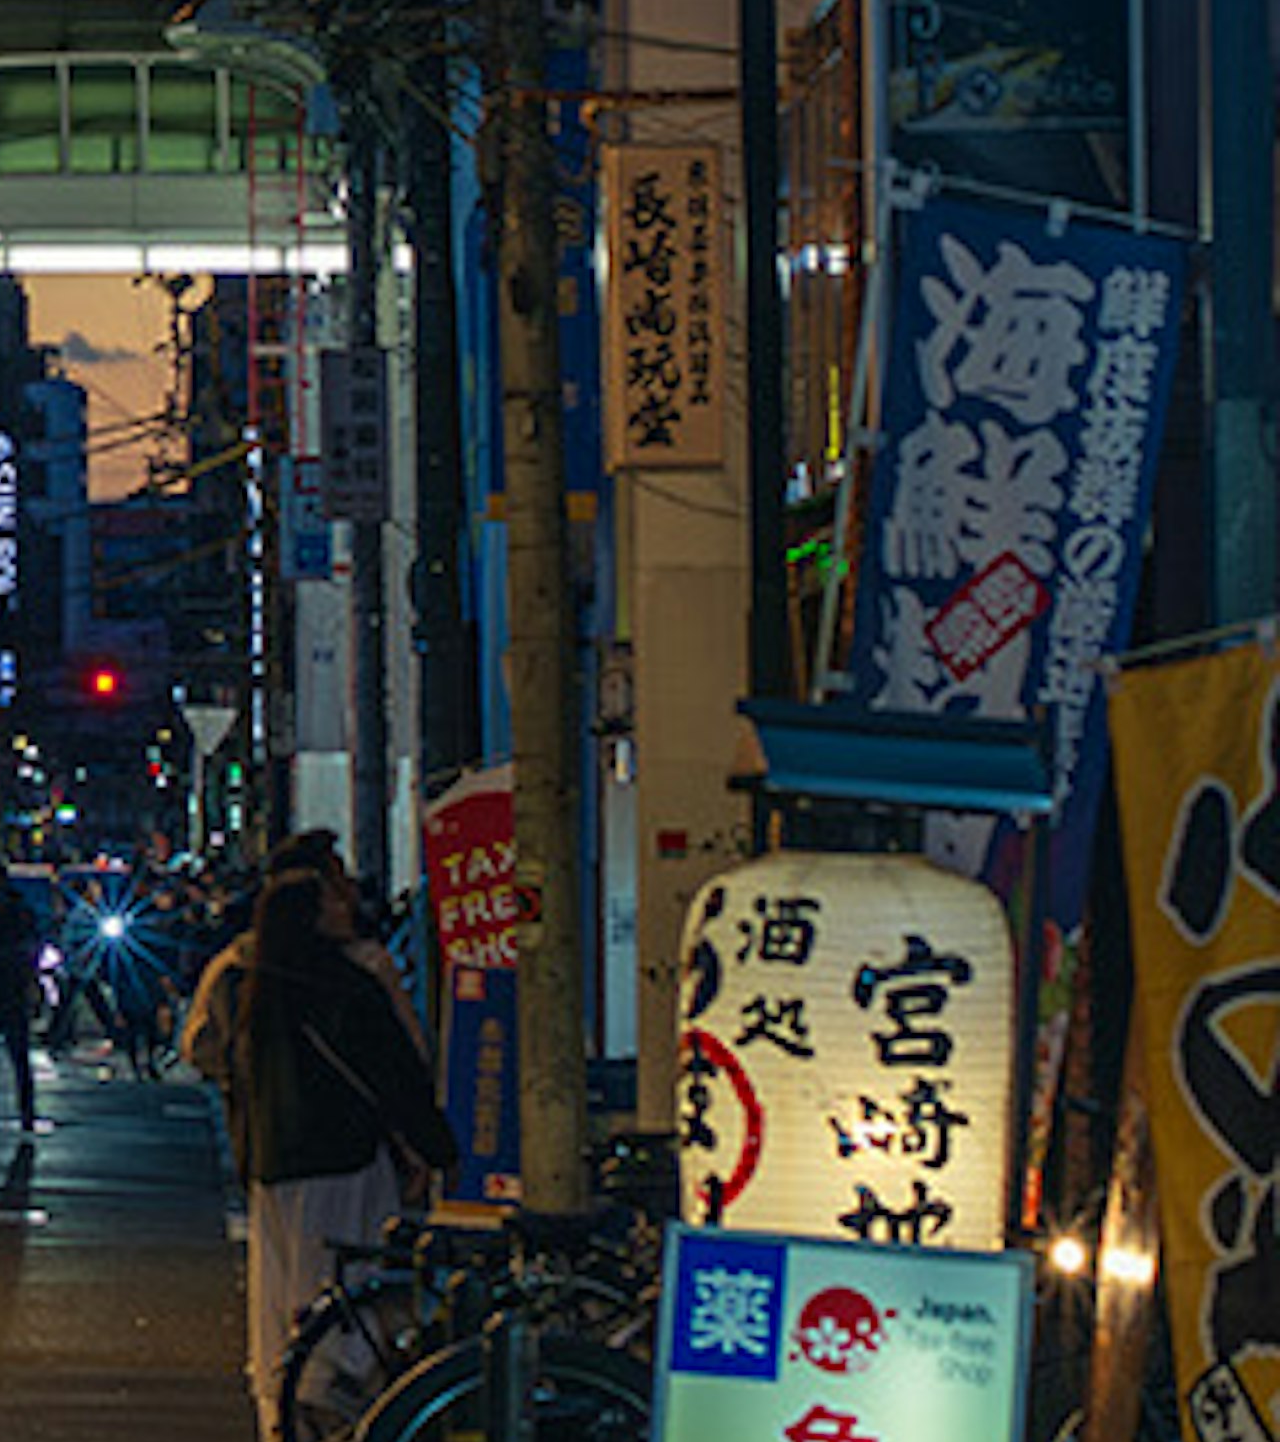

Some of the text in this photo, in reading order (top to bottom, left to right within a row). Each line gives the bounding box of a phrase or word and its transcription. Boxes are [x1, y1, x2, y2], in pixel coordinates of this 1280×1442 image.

[439, 839, 517, 888] TAX
[438, 887, 518, 934] FRE
[734, 894, 822, 1063] 酒処
[689, 1268, 774, 1360] 薬
